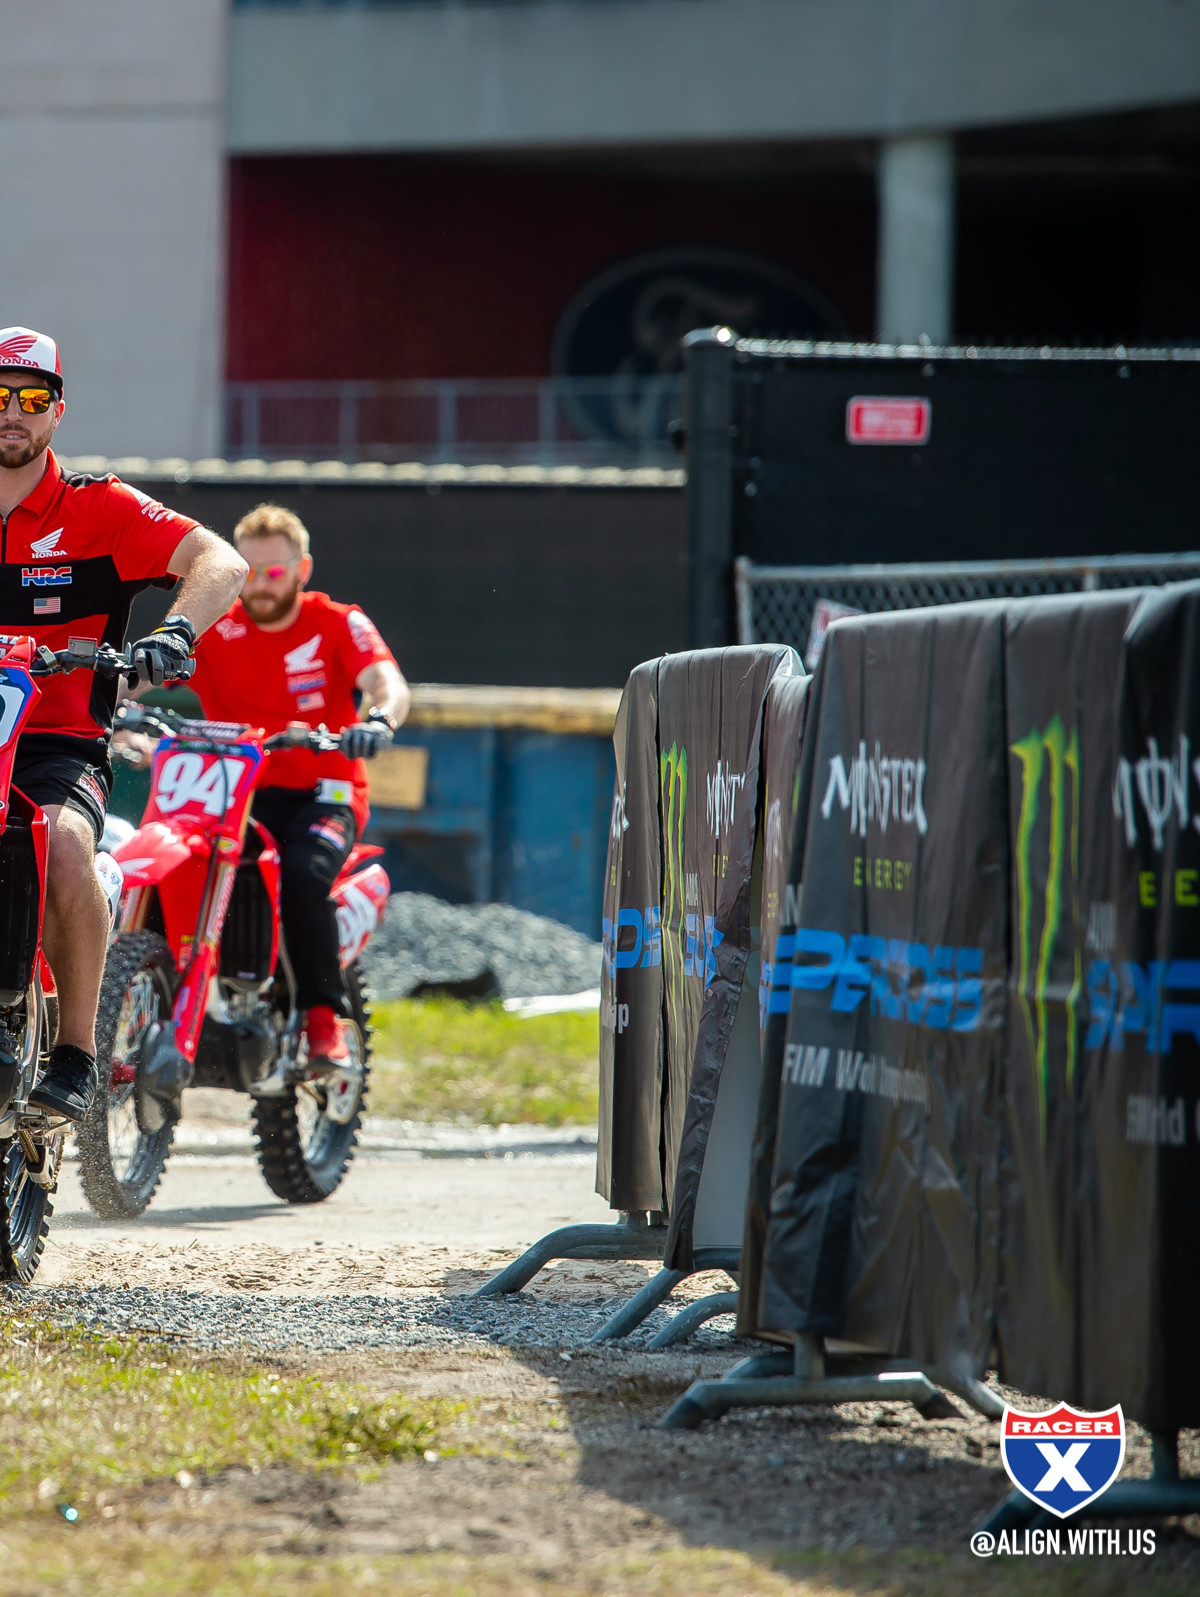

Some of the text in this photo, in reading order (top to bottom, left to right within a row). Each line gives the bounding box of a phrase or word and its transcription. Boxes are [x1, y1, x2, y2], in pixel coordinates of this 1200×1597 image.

[31, 550, 68, 559] HONDA
[22, 566, 72, 587] HRC
[155, 753, 245, 816] 94
